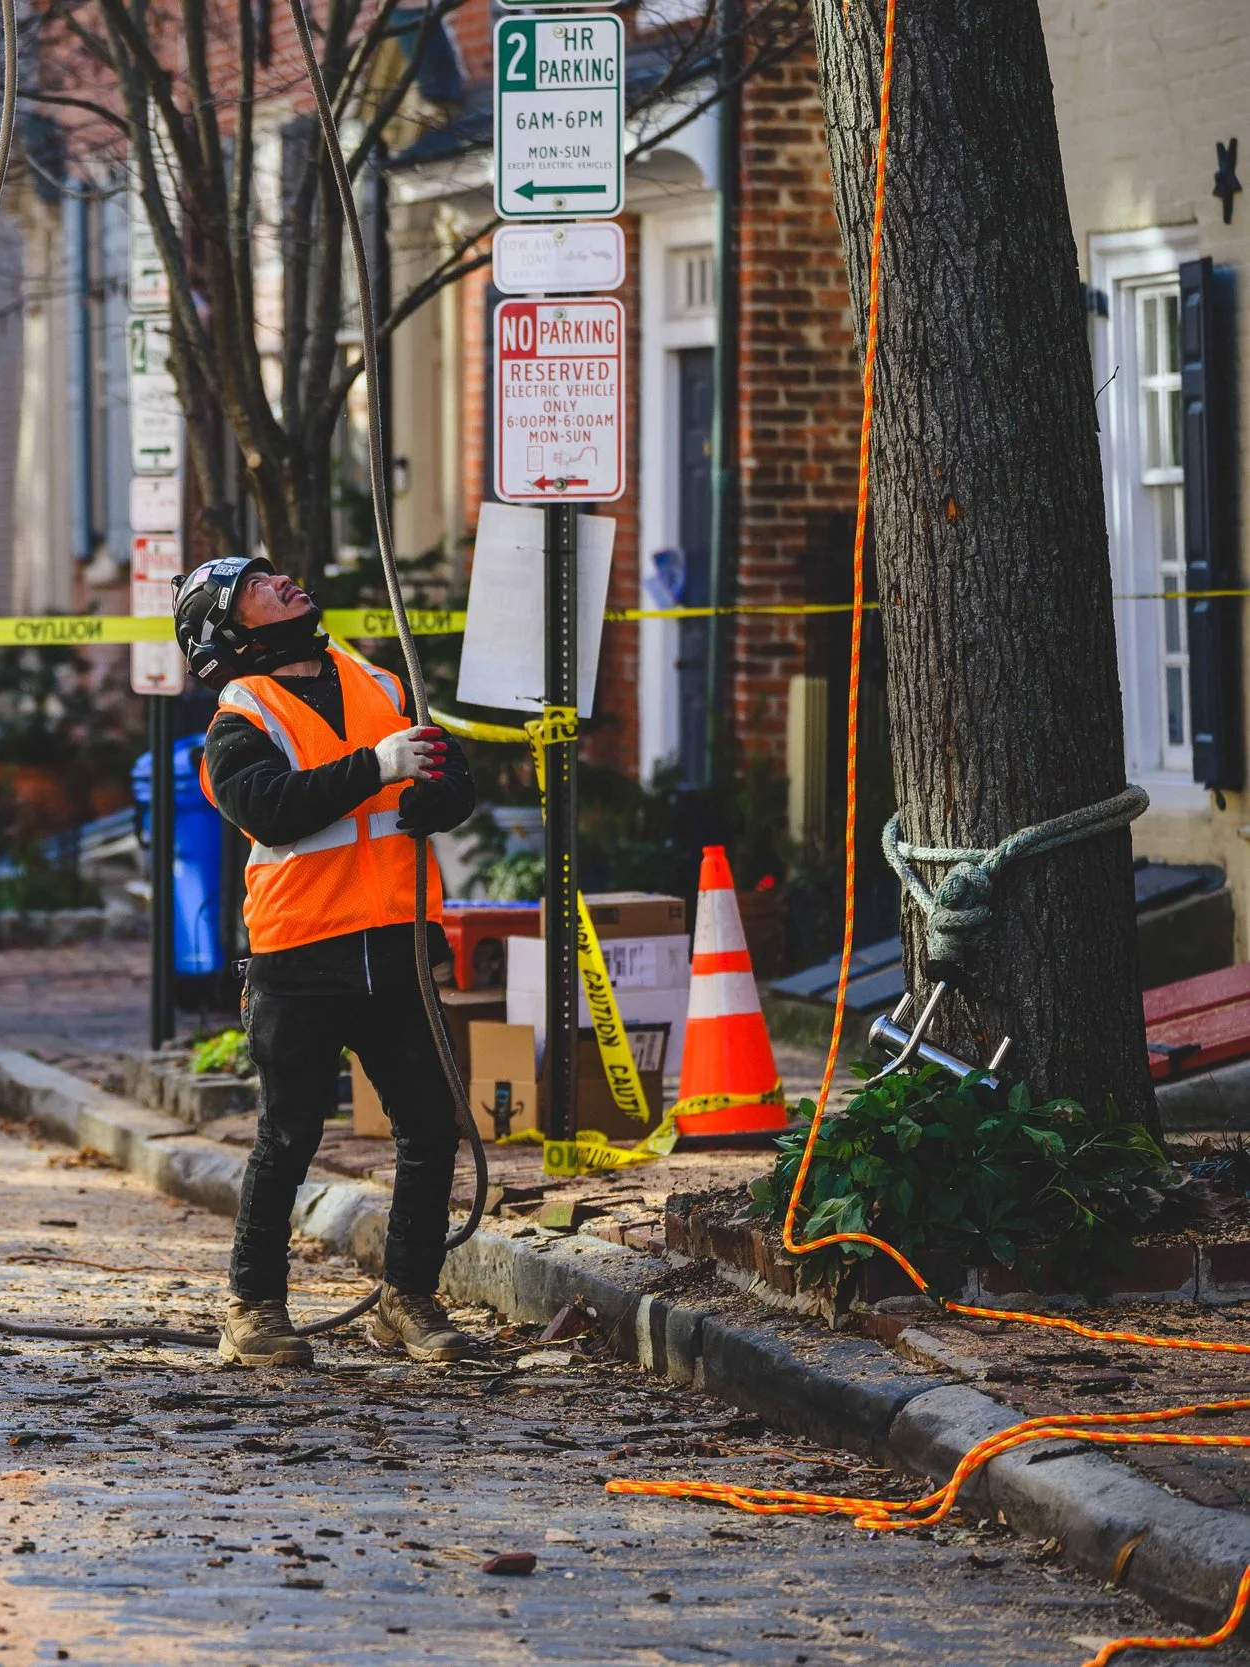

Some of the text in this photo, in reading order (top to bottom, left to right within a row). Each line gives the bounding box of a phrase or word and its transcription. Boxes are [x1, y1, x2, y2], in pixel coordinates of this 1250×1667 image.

[506, 27, 594, 81] 2 HR
[538, 57, 614, 84] PARKING
[516, 110, 603, 130] 6AM-6PM
[528, 145, 591, 159] MON-SUN
[507, 161, 613, 170] EXCEPT ELECTRIC VEHICLES
[502, 315, 615, 351] NO PARKING
[510, 362, 609, 382] RESERVED
[505, 384, 615, 398] ELECTRIC VEHICLE
[543, 400, 577, 413] ONLY
[507, 414, 614, 428] 6:00PM-6:00AM
[529, 430, 591, 444] MON-SUN
[583, 969, 621, 1048] CAUTION
